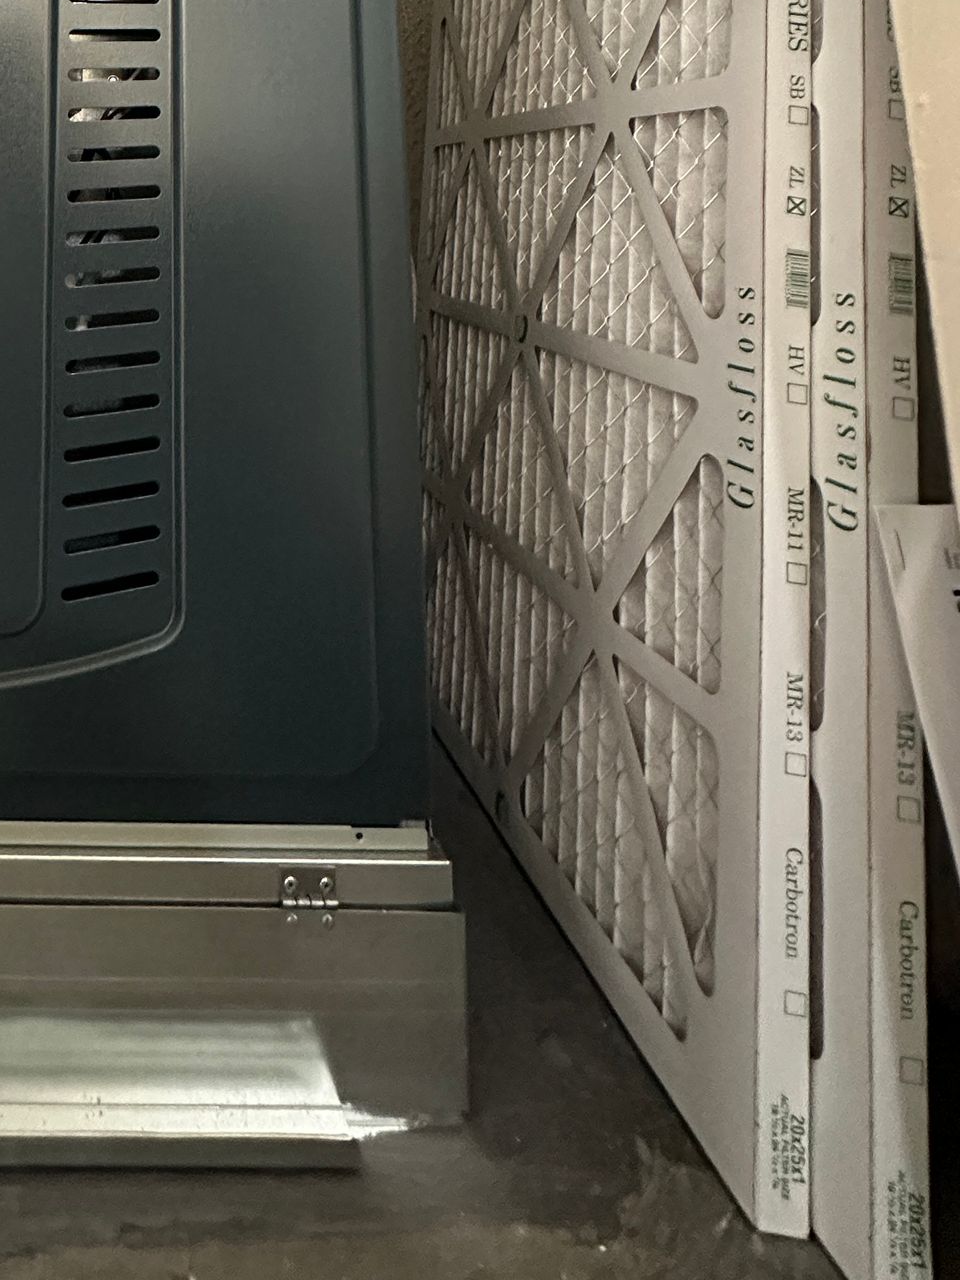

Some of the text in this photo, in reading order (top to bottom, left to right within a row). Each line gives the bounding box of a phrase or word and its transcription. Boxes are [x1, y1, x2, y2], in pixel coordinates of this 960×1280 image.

[789, 75, 806, 99] SB
[789, 165, 805, 188] ZL
[891, 164, 907, 188] ZL
[788, 345, 805, 376] HV
[893, 356, 911, 390] HV
[727, 287, 757, 509] Glasfloss
[823, 292, 859, 532] Glasfloss
[787, 487, 805, 551] MR-11
[786, 673, 804, 743] MR-13
[896, 710, 917, 787] MR-13
[785, 847, 804, 960] Carbotron
[899, 900, 920, 1021] Carbotron
[781, 1093, 789, 1135] ACTUAL
[790, 1114, 806, 1184] 20x25x1
[908, 1192, 927, 1269] 20x25x1
